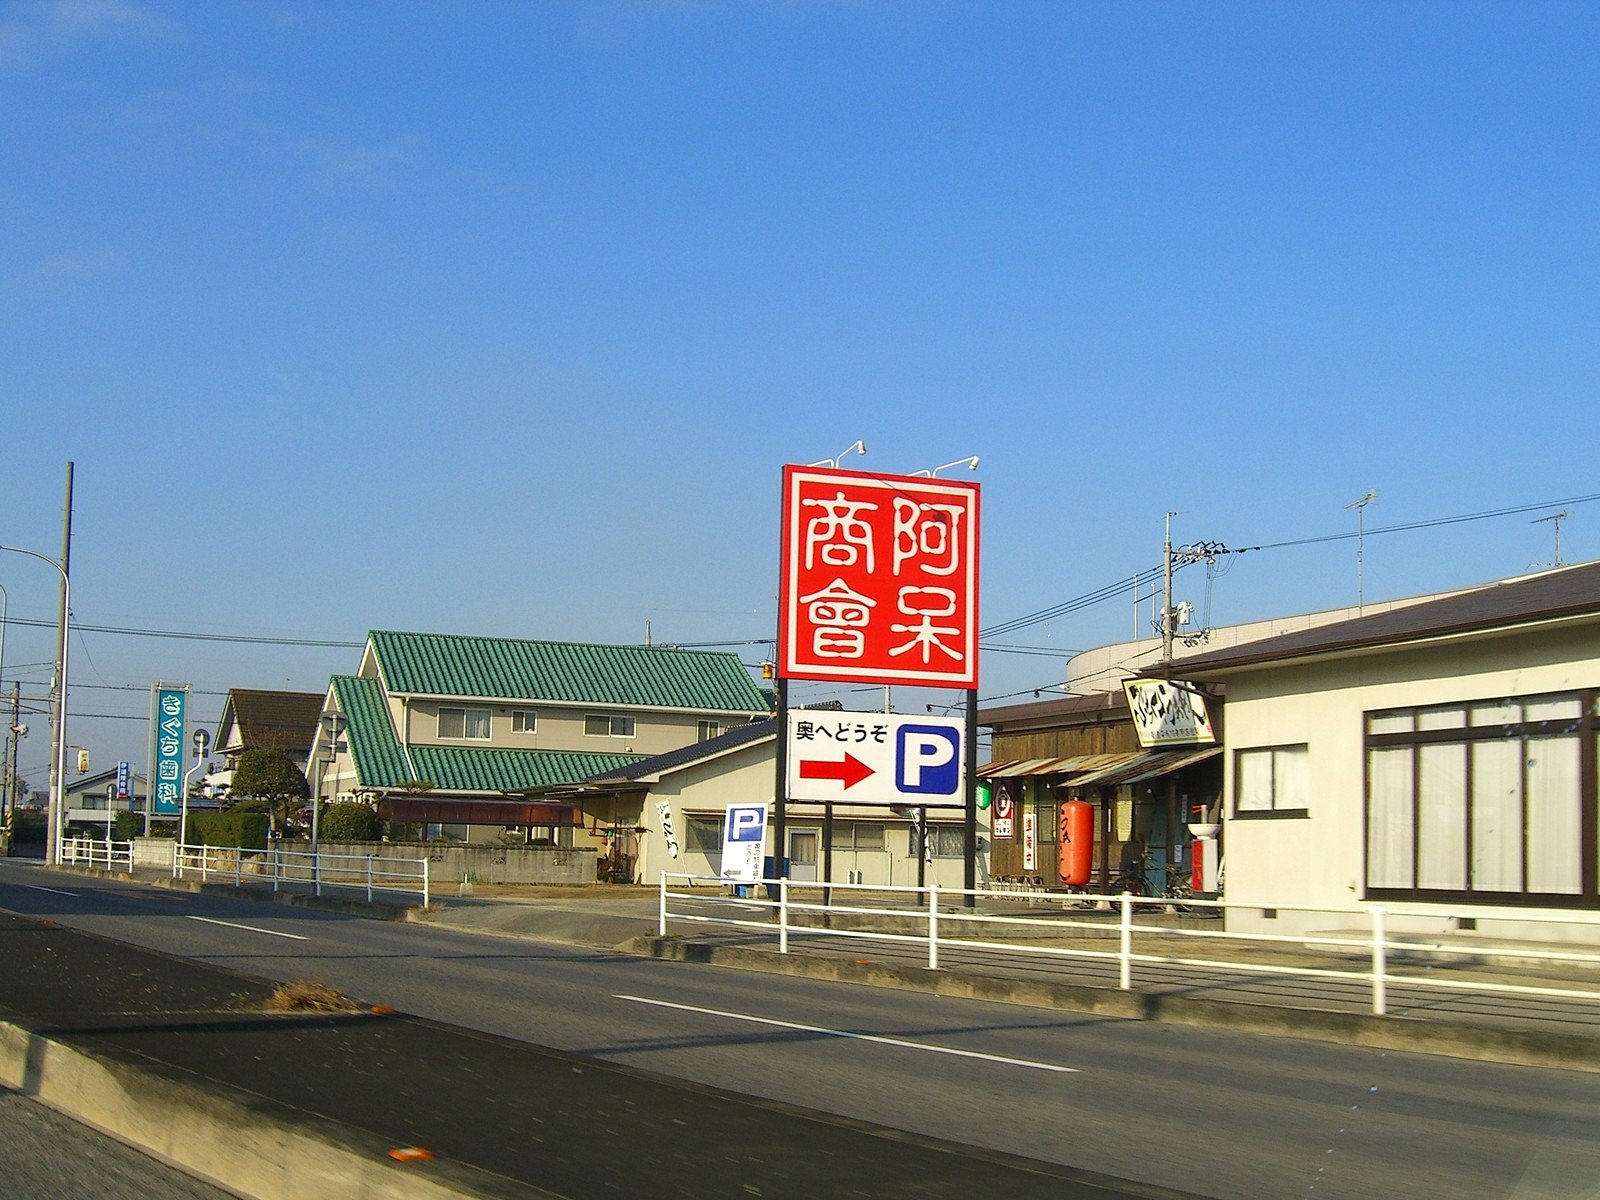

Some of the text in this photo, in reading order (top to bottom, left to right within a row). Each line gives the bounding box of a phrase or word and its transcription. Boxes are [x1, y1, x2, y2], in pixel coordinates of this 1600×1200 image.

[799, 491, 879, 659] 商會
[888, 496, 965, 665] 阿呆
[158, 694, 181, 805] きぐち歯科
[796, 721, 889, 743] 奥へどうぞ
[903, 732, 955, 786] P
[732, 809, 760, 840] P
